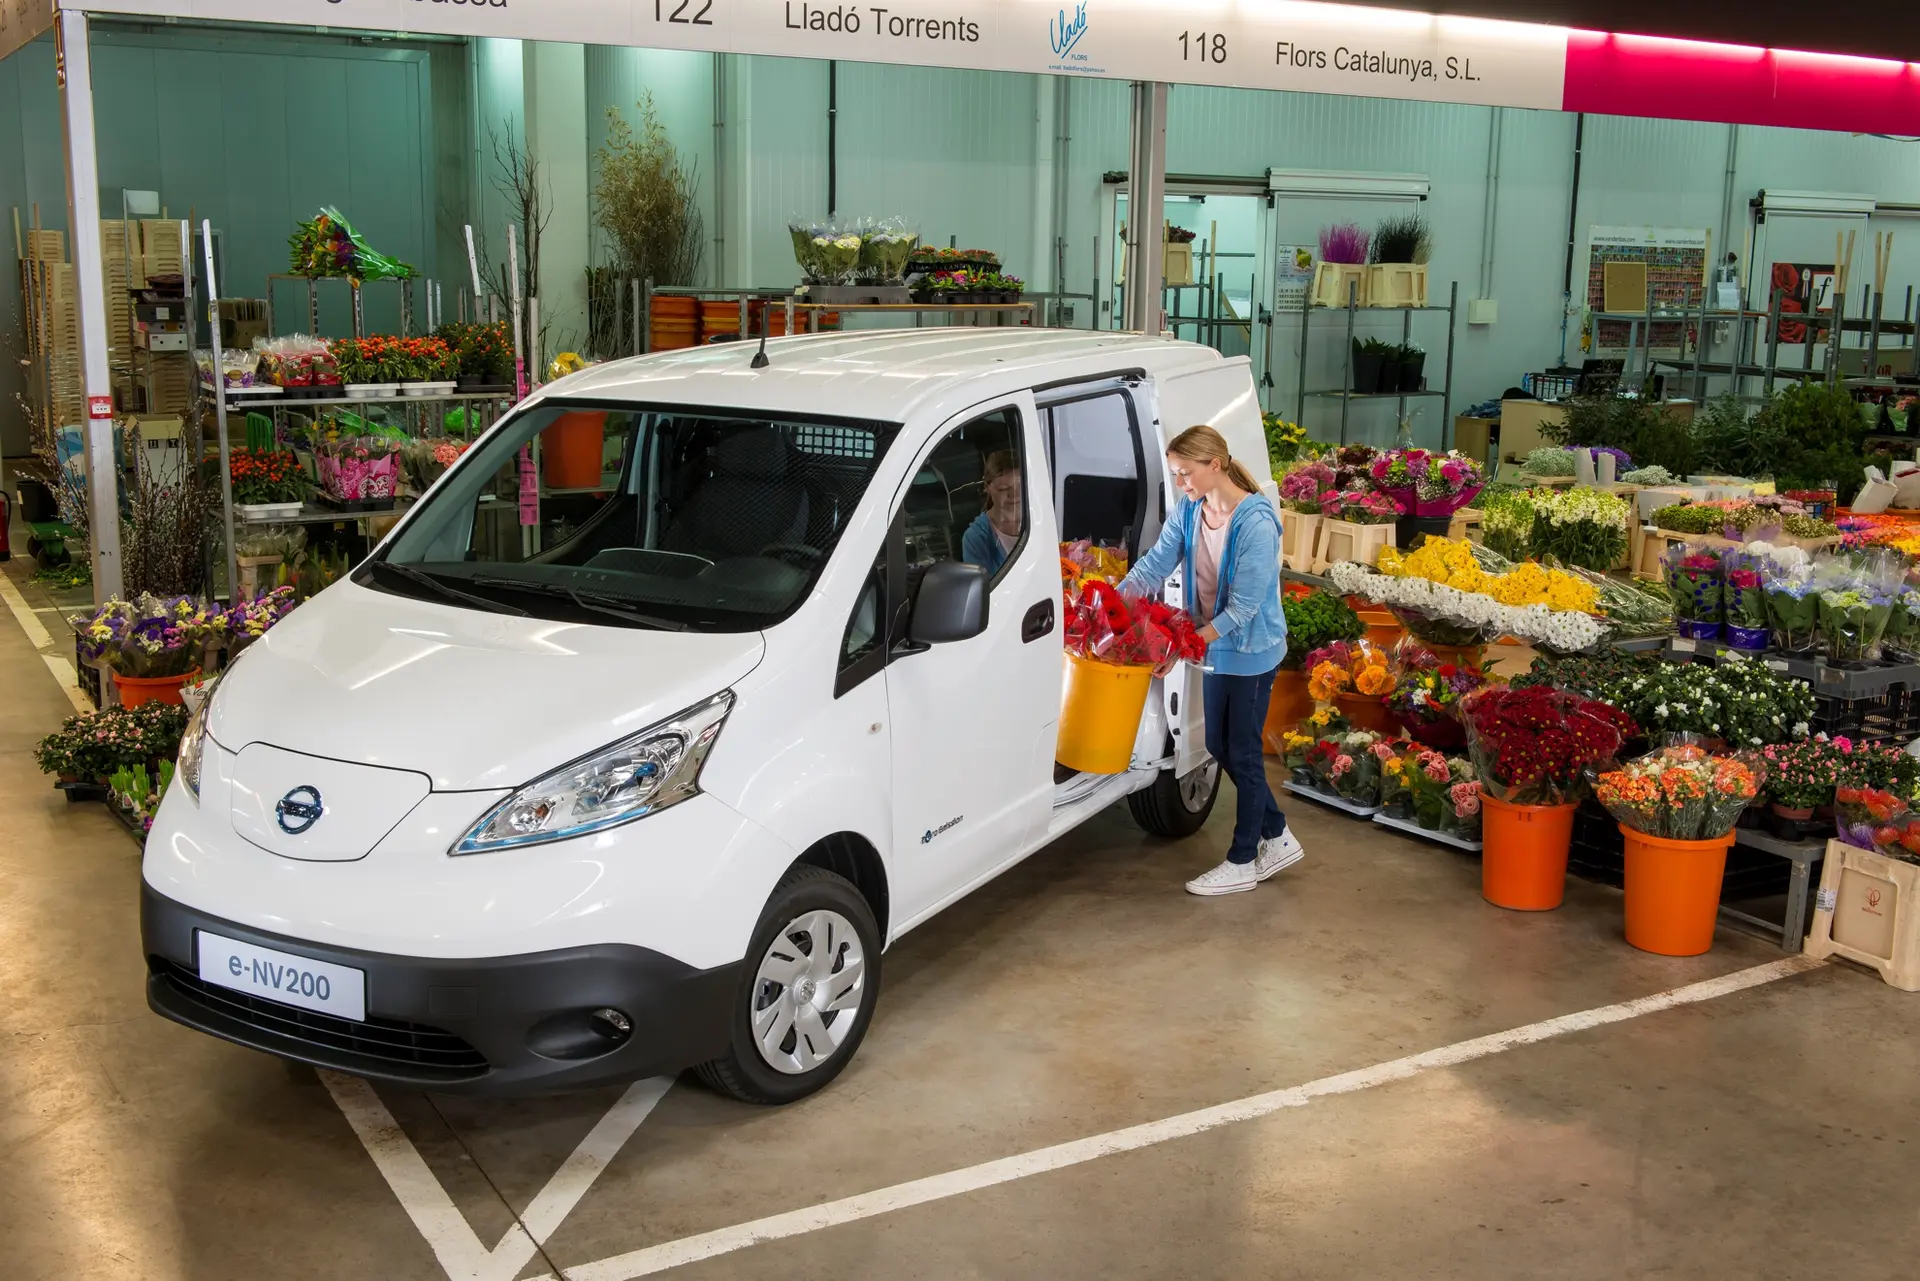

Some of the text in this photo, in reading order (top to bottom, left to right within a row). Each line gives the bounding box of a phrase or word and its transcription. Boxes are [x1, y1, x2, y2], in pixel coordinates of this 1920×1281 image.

[786, 1, 979, 42] Lladó Torrents
[1178, 30, 1227, 64] 118
[1276, 42, 1481, 82] Flors Catalunya, S.L.
[228, 955, 331, 1001] e-NV200
